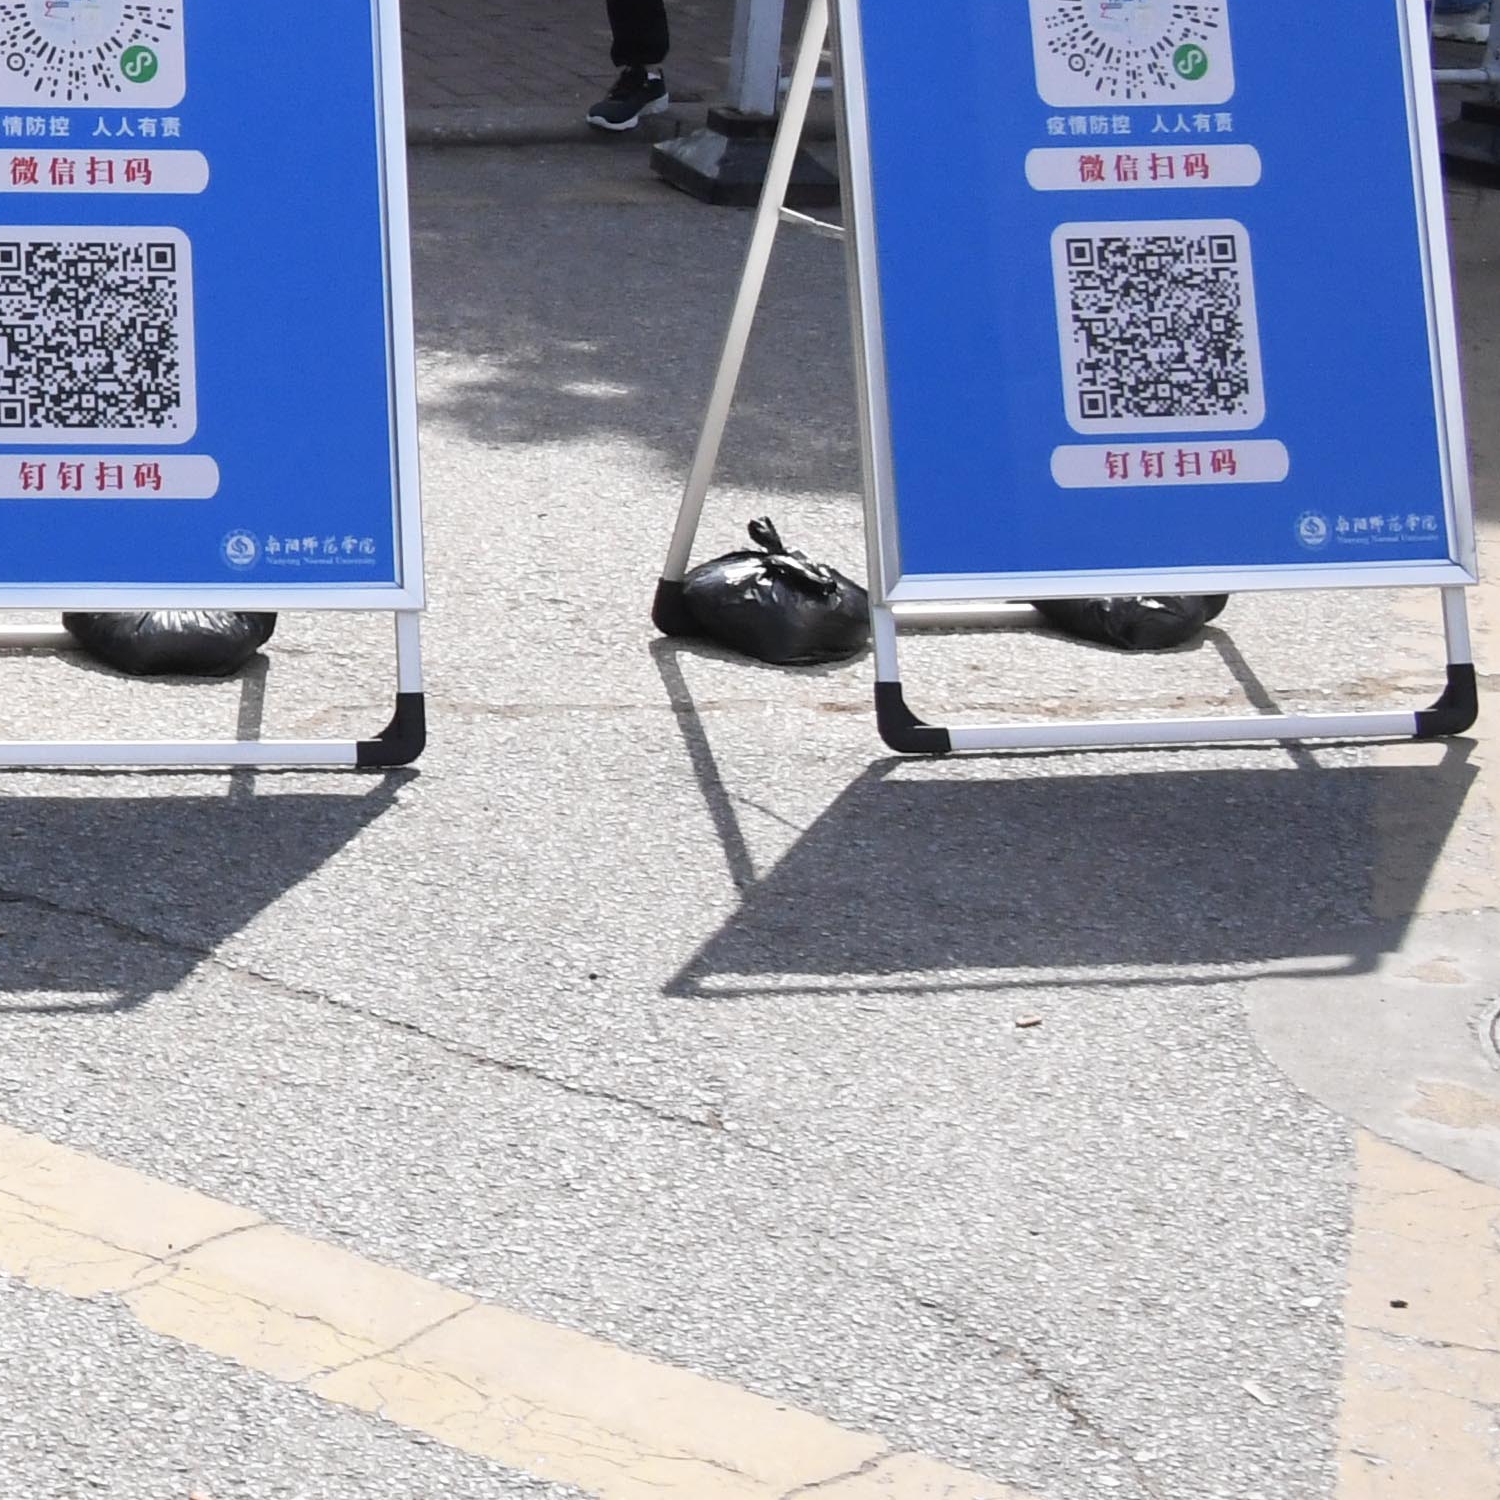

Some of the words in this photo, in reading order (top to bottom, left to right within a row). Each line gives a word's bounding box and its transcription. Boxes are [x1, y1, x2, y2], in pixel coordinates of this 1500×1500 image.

[93, 117, 180, 137] 人人有责
[1047, 115, 1131, 135] 疫情防控
[1152, 113, 1232, 132] 人人有责
[8, 156, 152, 185] 微信扫码
[1078, 154, 1209, 181] 微信扫码
[18, 461, 163, 490] 钉钉扫码
[1104, 448, 1237, 478] 钉钉扫码
[265, 534, 376, 554] 南阳师范学院
